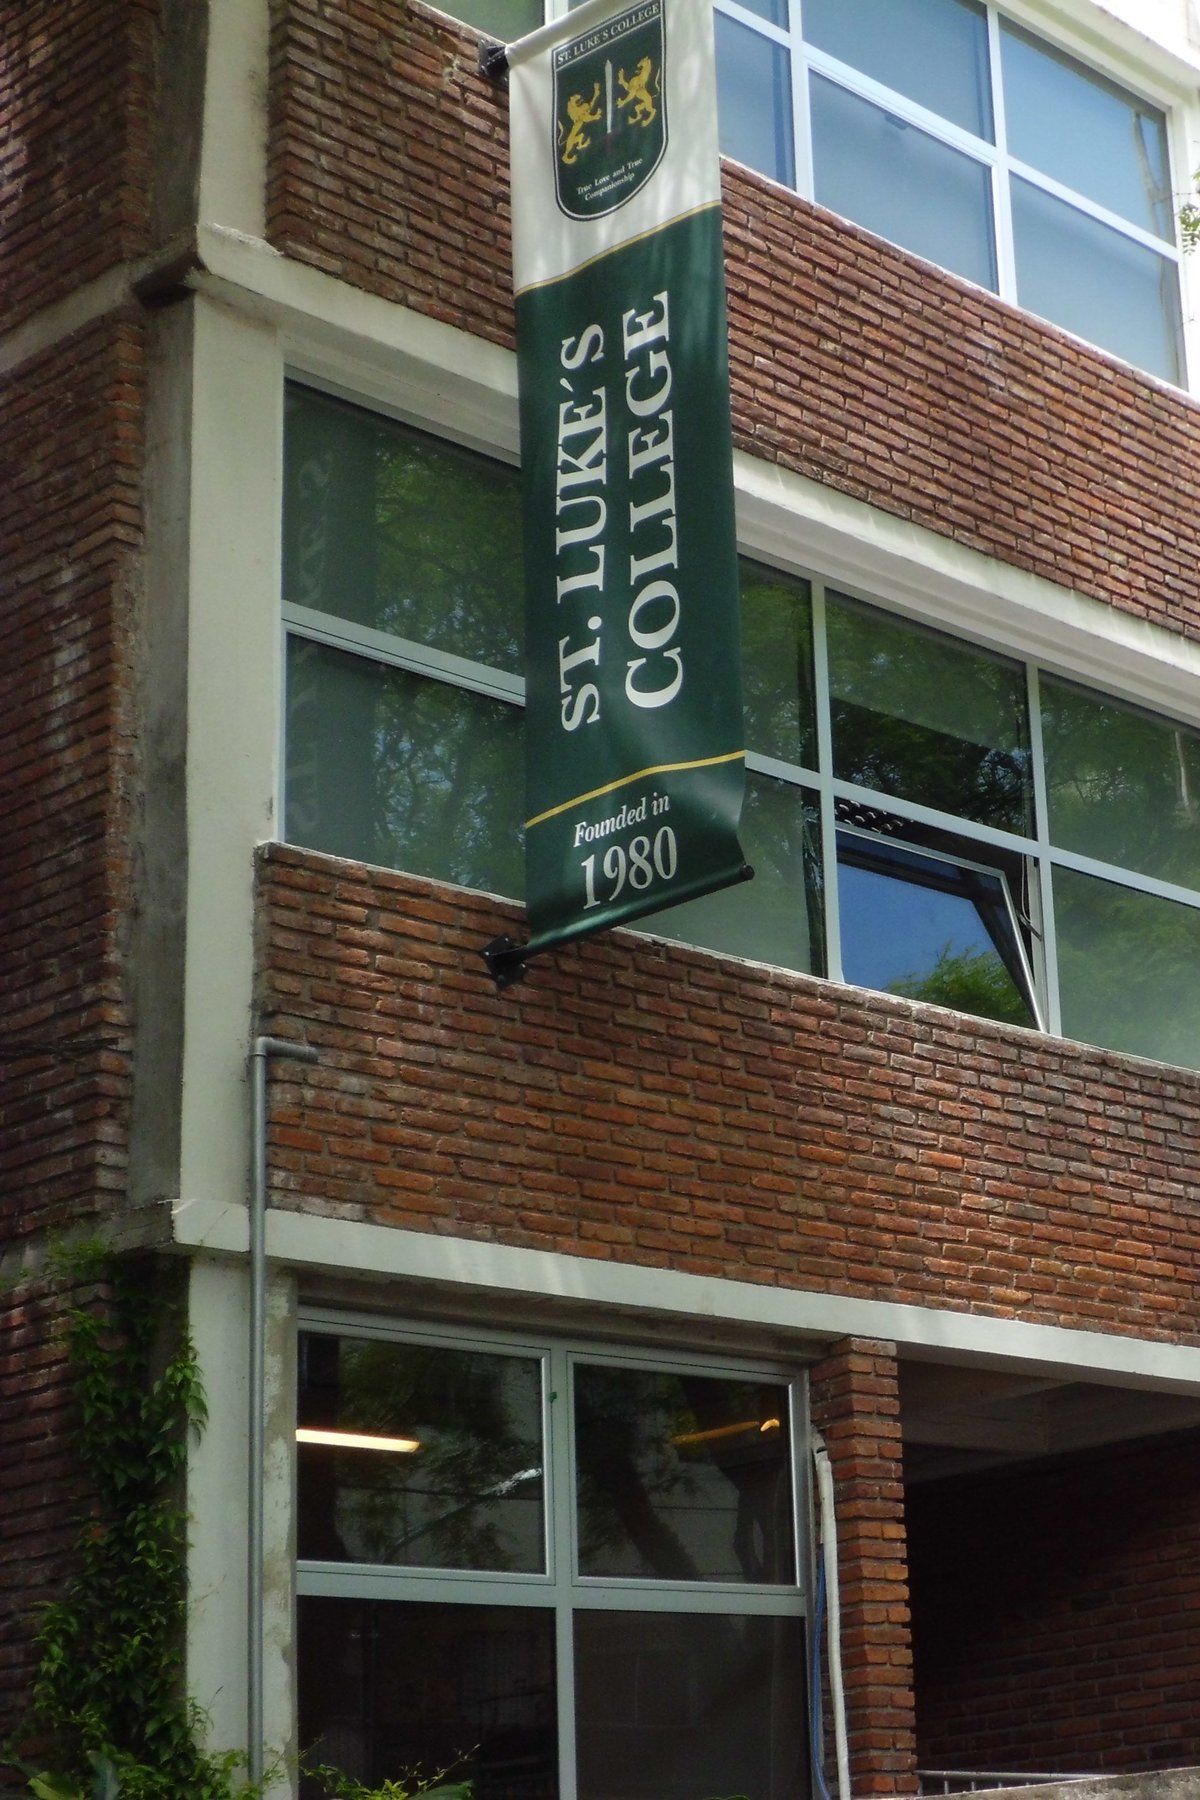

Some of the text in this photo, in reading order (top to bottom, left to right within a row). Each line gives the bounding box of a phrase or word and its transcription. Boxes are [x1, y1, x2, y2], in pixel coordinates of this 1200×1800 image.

[610, 2, 661, 36] COLLEGE
[556, 323, 606, 731] ST. LUKE'S
[622, 290, 684, 709] COLLEGE
[572, 791, 671, 848] Founded in
[581, 825, 678, 910] 1980
